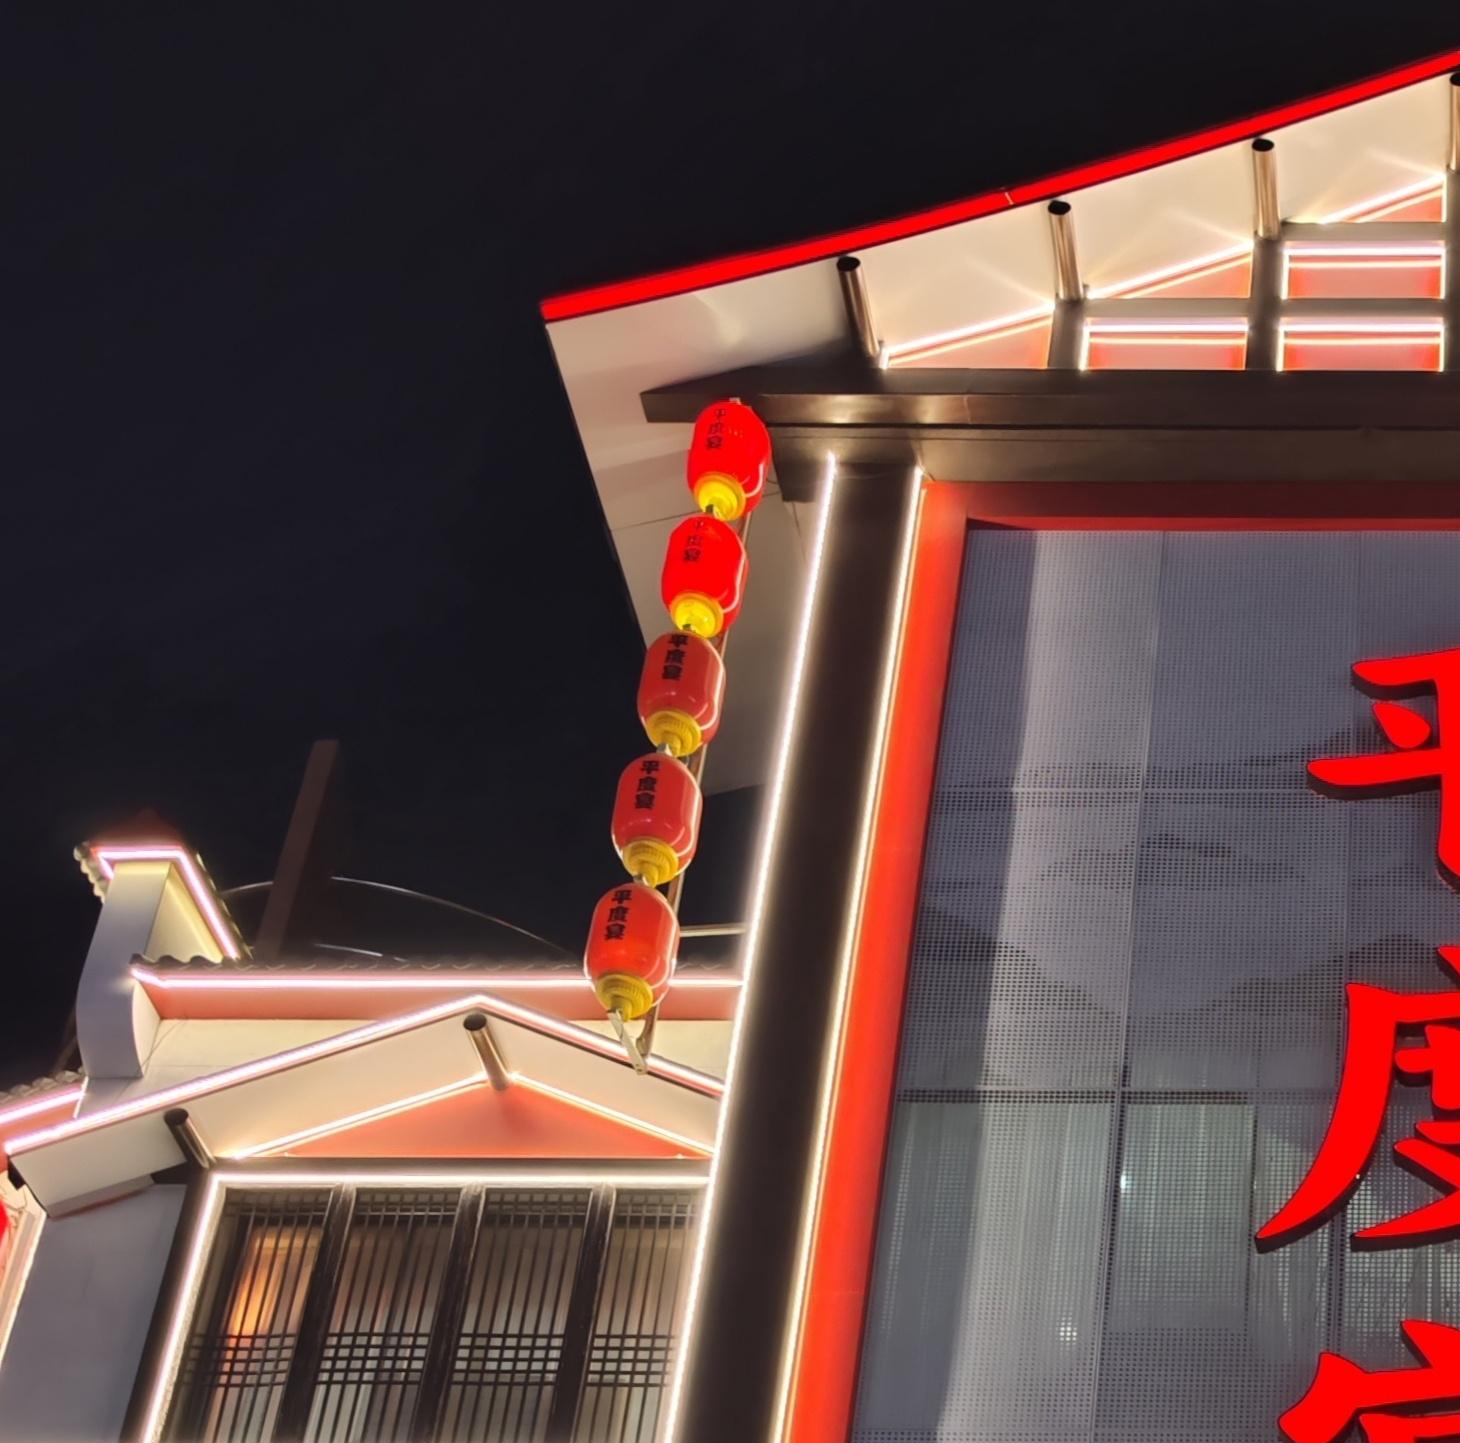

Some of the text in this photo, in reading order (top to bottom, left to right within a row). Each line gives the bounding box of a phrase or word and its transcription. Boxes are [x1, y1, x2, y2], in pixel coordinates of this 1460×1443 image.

[634, 760, 660, 809] 平度宴
[604, 889, 633, 941] 平度宴
